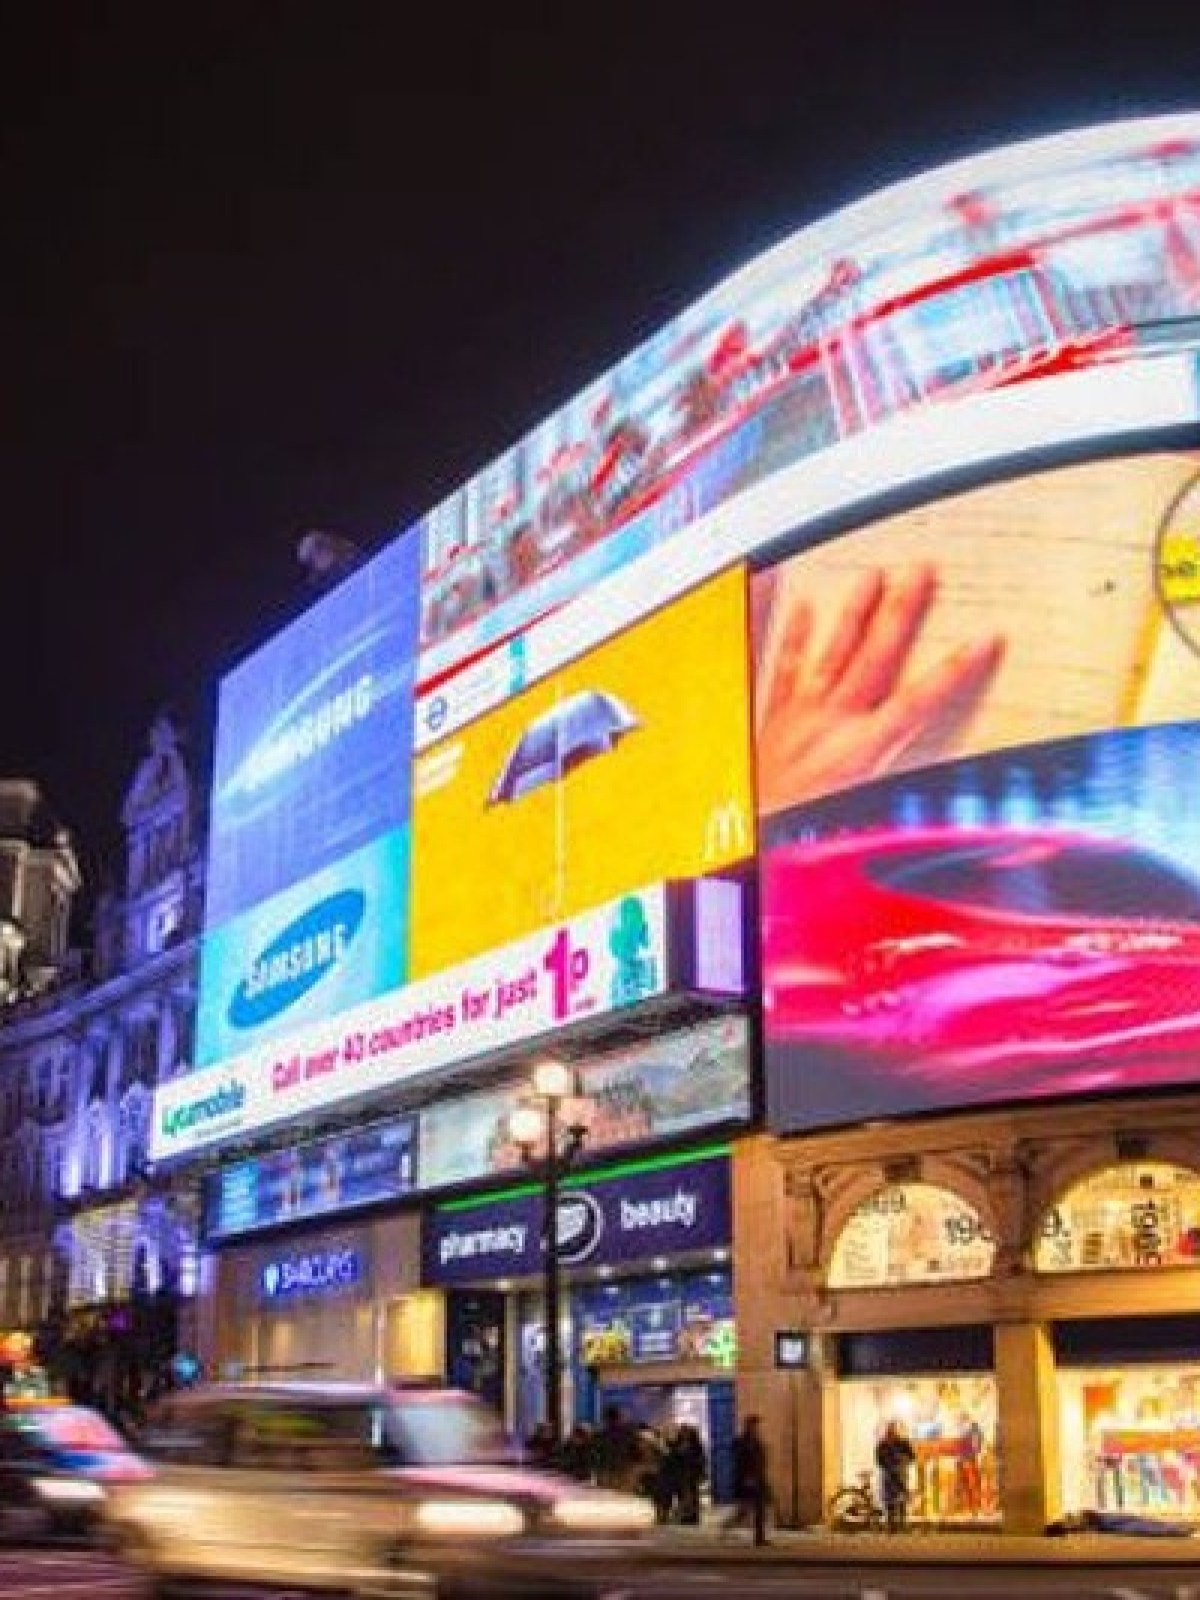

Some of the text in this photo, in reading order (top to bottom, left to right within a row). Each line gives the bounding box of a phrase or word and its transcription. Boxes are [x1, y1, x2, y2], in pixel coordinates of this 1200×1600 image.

[241, 921, 350, 999] SAMSUNG
[272, 1053, 301, 1091] Call
[305, 1046, 339, 1080] over
[368, 1004, 456, 1057] countries
[461, 986, 491, 1023] for
[492, 965, 538, 1020] just
[542, 926, 590, 1021] 1p
[439, 1223, 527, 1264] pharmacy
[620, 1185, 697, 1231] beauty
